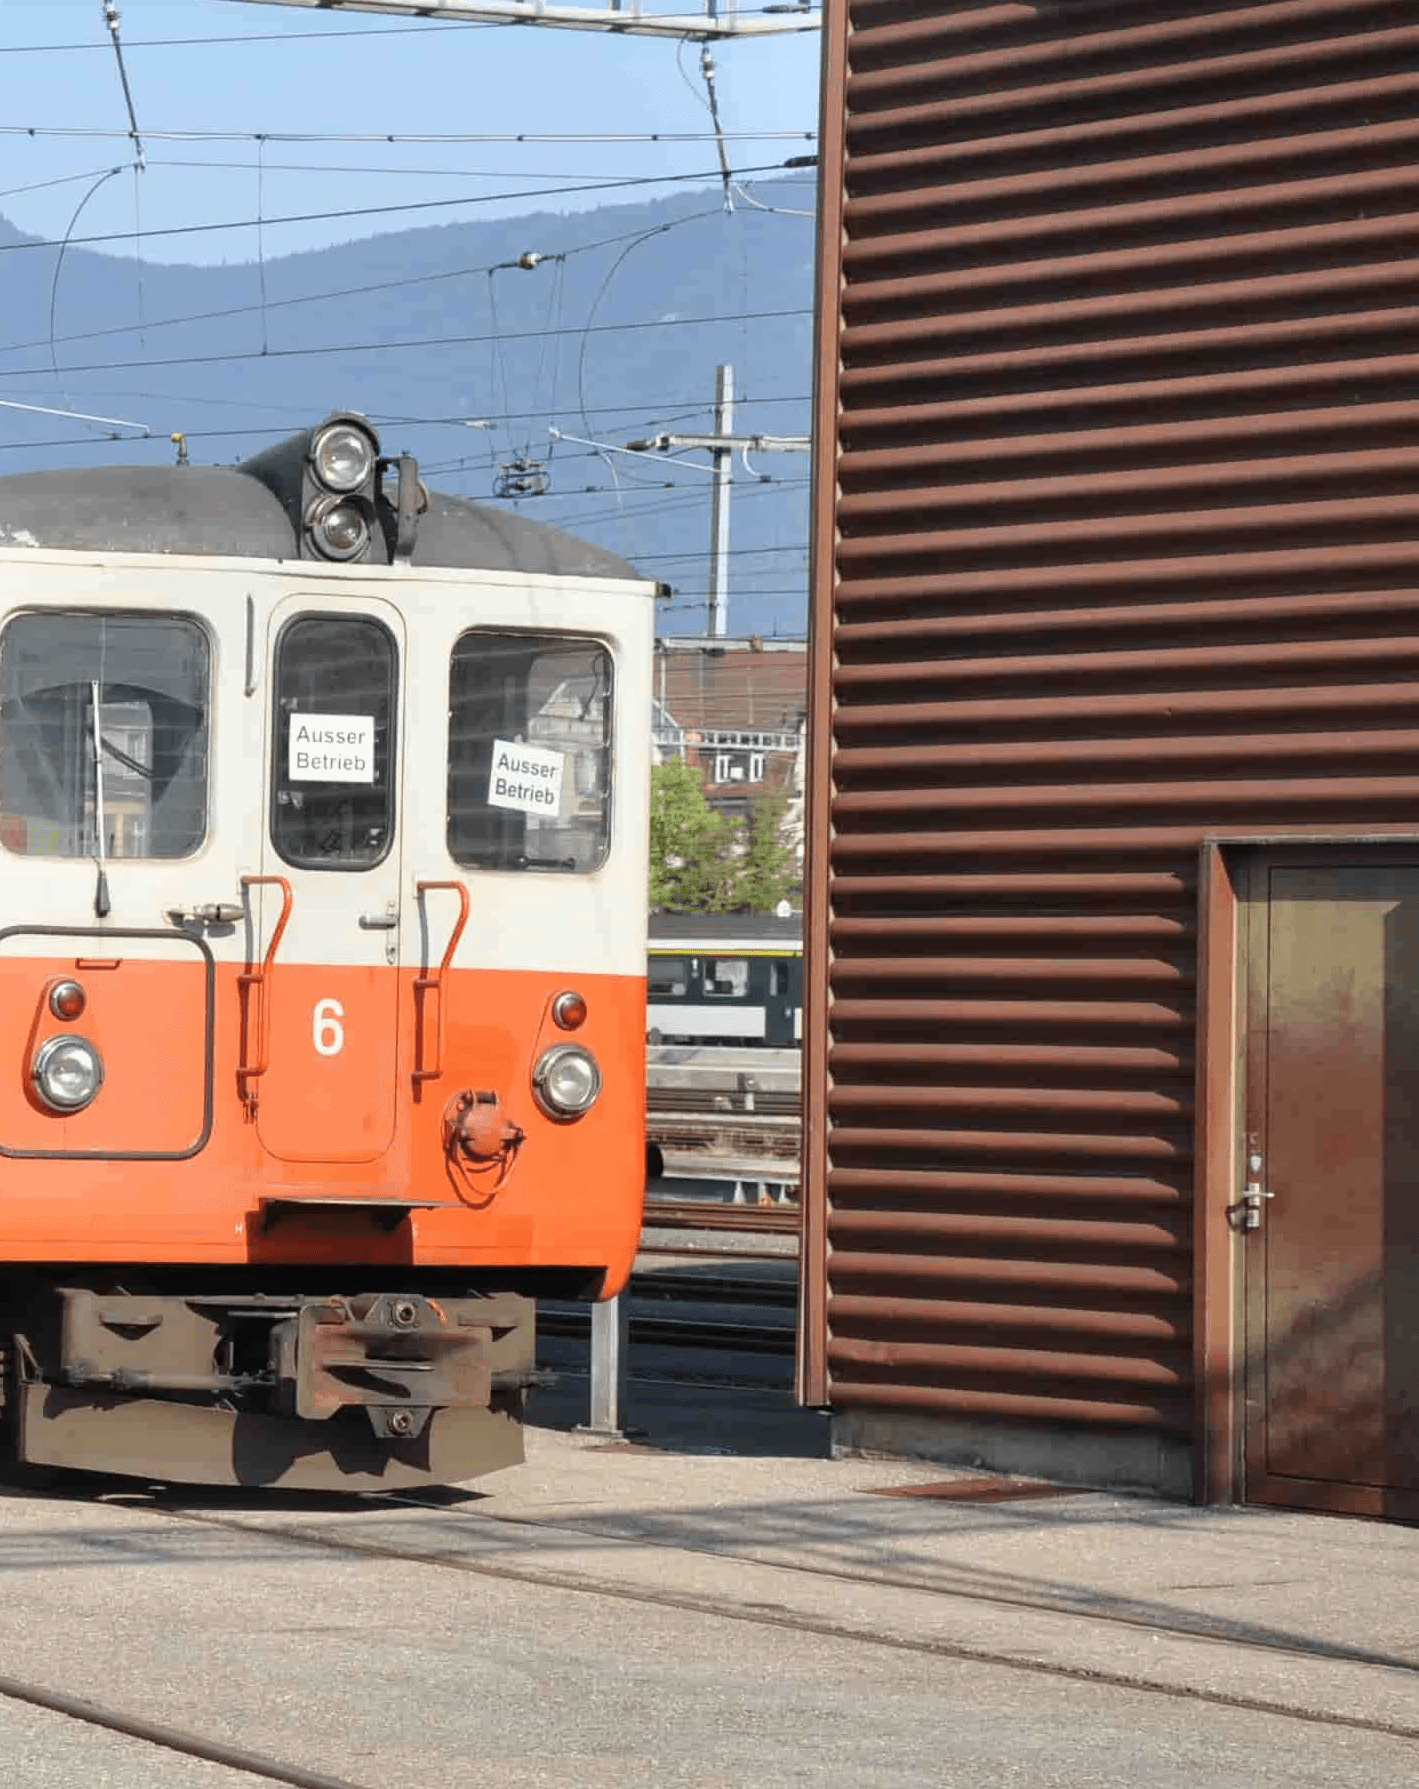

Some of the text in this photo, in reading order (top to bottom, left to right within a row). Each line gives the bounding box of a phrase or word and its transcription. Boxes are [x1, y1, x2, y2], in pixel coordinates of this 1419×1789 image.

[296, 725, 366, 745] Ausser
[296, 752, 366, 771] Betrieb
[497, 753, 558, 779] Ausser
[494, 778, 556, 806] Betrieb
[313, 998, 344, 1055] 6
